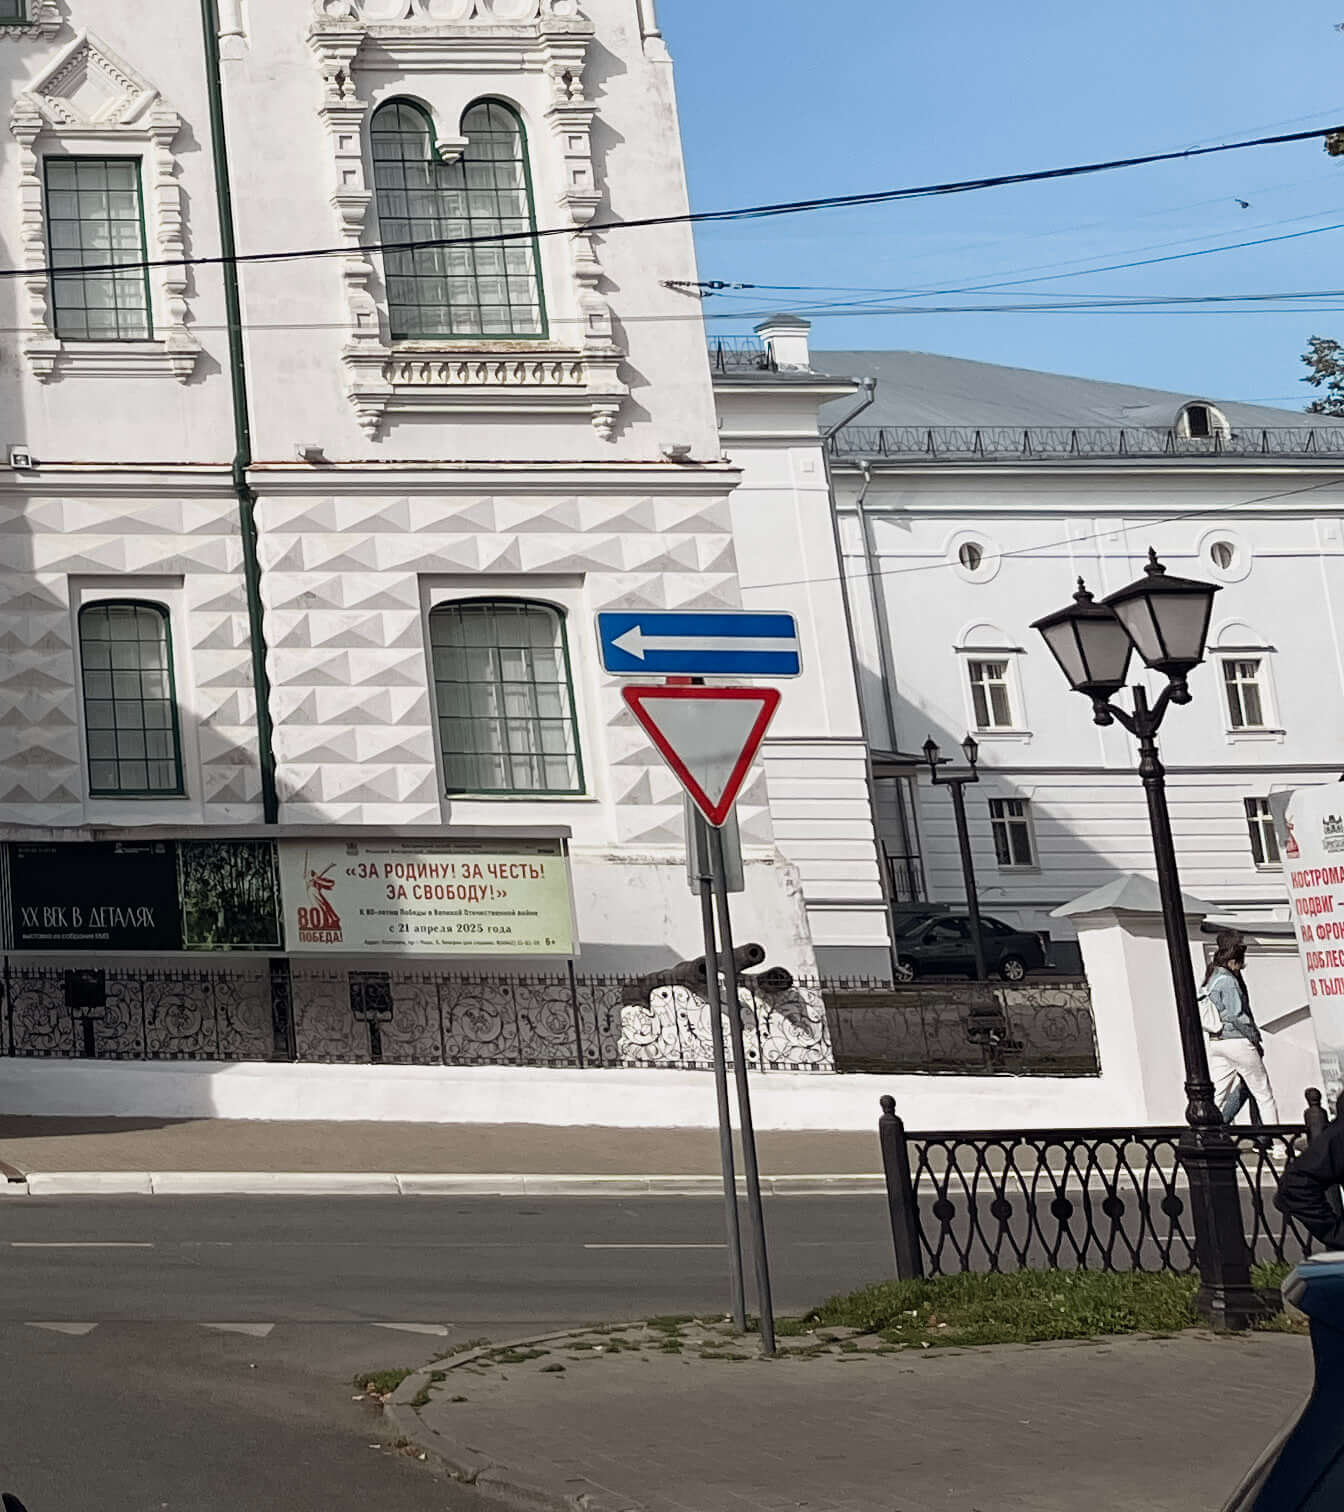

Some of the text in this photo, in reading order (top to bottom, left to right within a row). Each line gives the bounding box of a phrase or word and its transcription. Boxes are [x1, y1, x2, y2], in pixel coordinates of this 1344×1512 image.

[345, 863, 545, 882] «ЗА РОДИНУ! ЗА ЧЕСТЬ!
[385, 884, 507, 903] ЗА СВОБОДУ!»
[1295, 895, 1334, 918] ПОДВИГ
[43, 906, 68, 928] ВЕК
[72, 906, 82, 928] В
[89, 906, 156, 928] ДЕТАЛЯХ
[297, 907, 320, 930] 80
[298, 931, 344, 944] ПОБЕДА!
[389, 923, 512, 935] с 21 апреля 2025 года
[1310, 978, 1318, 996] В
